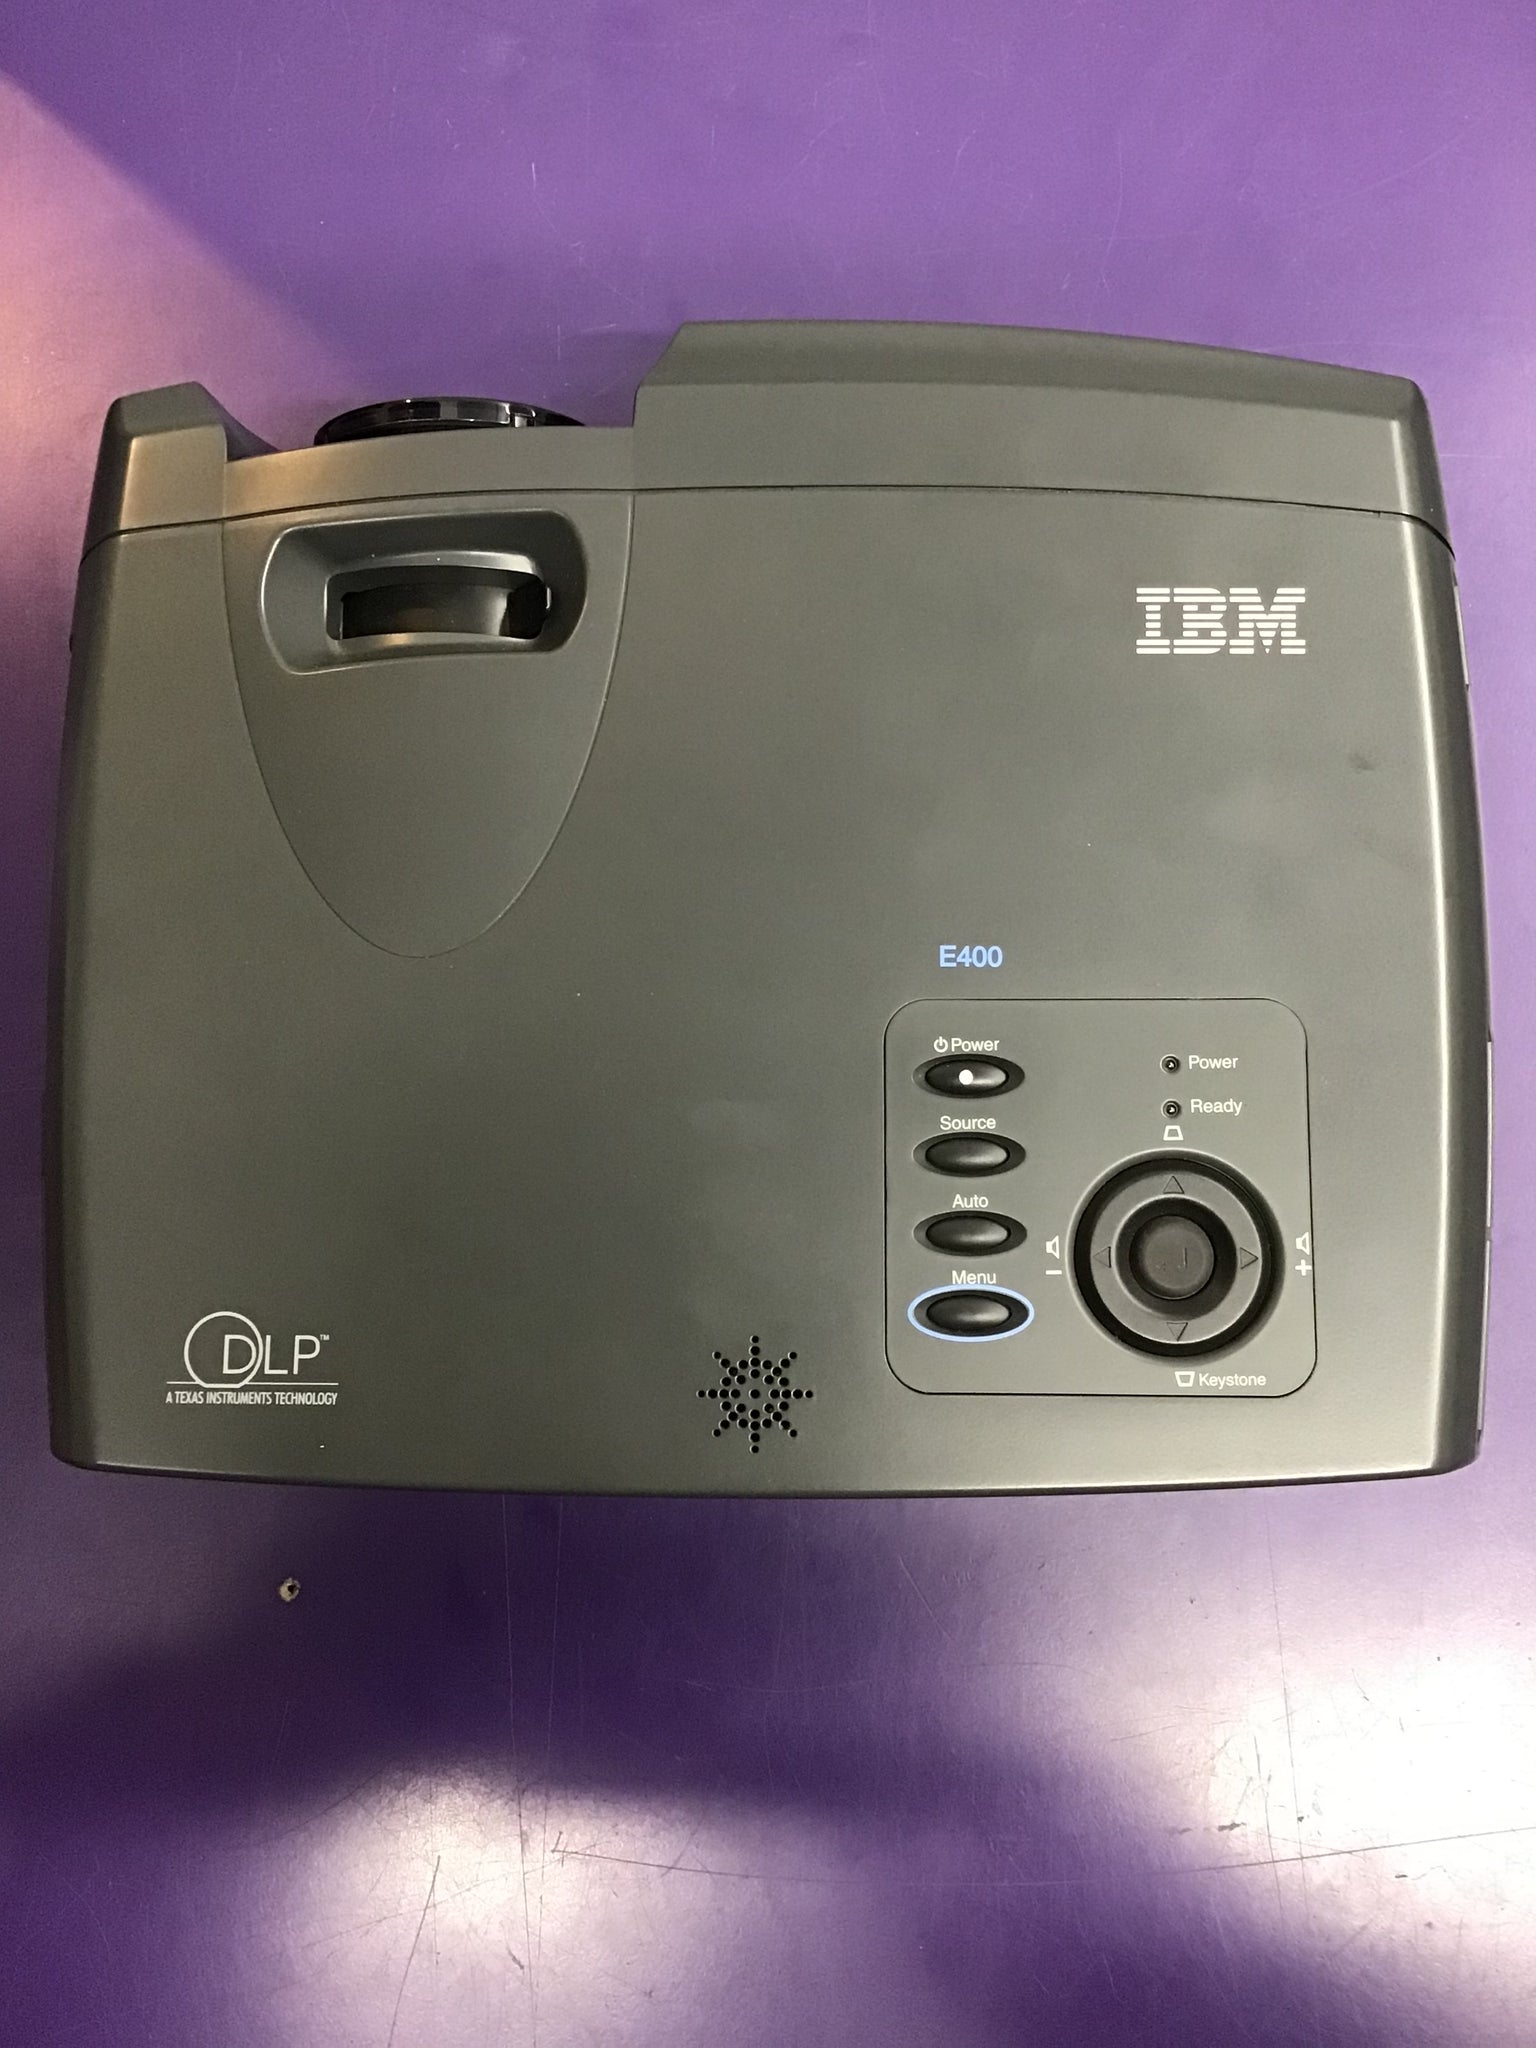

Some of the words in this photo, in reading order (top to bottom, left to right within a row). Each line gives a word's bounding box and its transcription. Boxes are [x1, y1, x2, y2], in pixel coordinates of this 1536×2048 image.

[1135, 587, 1307, 655] IBM
[939, 944, 1004, 968] E400
[951, 1036, 1000, 1053] Power
[1188, 1054, 1239, 1070] Power
[1190, 1097, 1243, 1117] Ready
[939, 1115, 997, 1131] Source
[952, 1193, 989, 1209] Auto
[951, 1270, 997, 1286] Menu
[1198, 1372, 1267, 1390] Keystone
[165, 1391, 173, 1404] A
[174, 1391, 204, 1405] TEXAS
[206, 1391, 272, 1405] INSTRUMENTS
[274, 1391, 338, 1406] TECHNOLOGY
